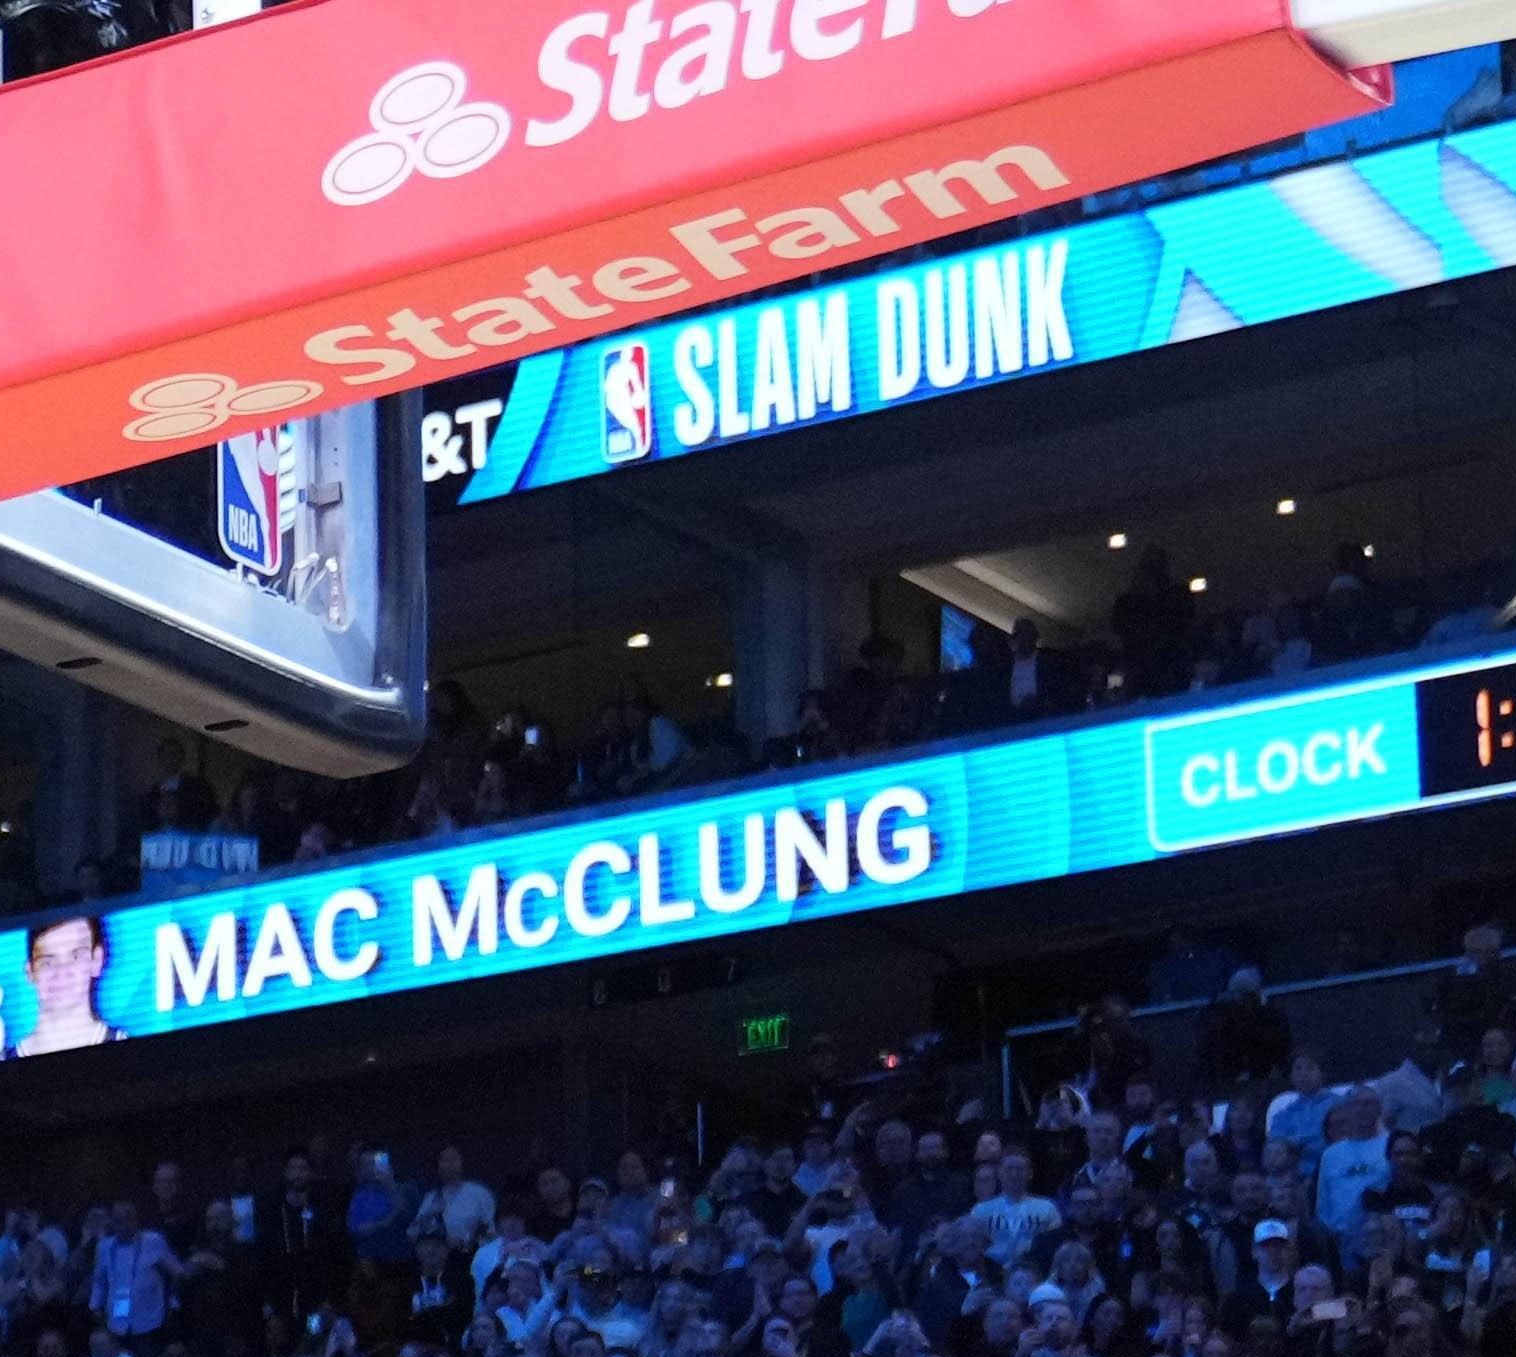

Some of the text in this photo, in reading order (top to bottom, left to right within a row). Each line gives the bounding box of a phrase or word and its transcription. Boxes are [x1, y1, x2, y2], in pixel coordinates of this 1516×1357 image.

[672, 239, 1073, 447] SLAM DUNK
[421, 398, 503, 482] &T
[228, 502, 259, 553] NBA
[1179, 722, 1388, 809] CLOCK
[152, 785, 934, 1013] MAC McCLUNG
